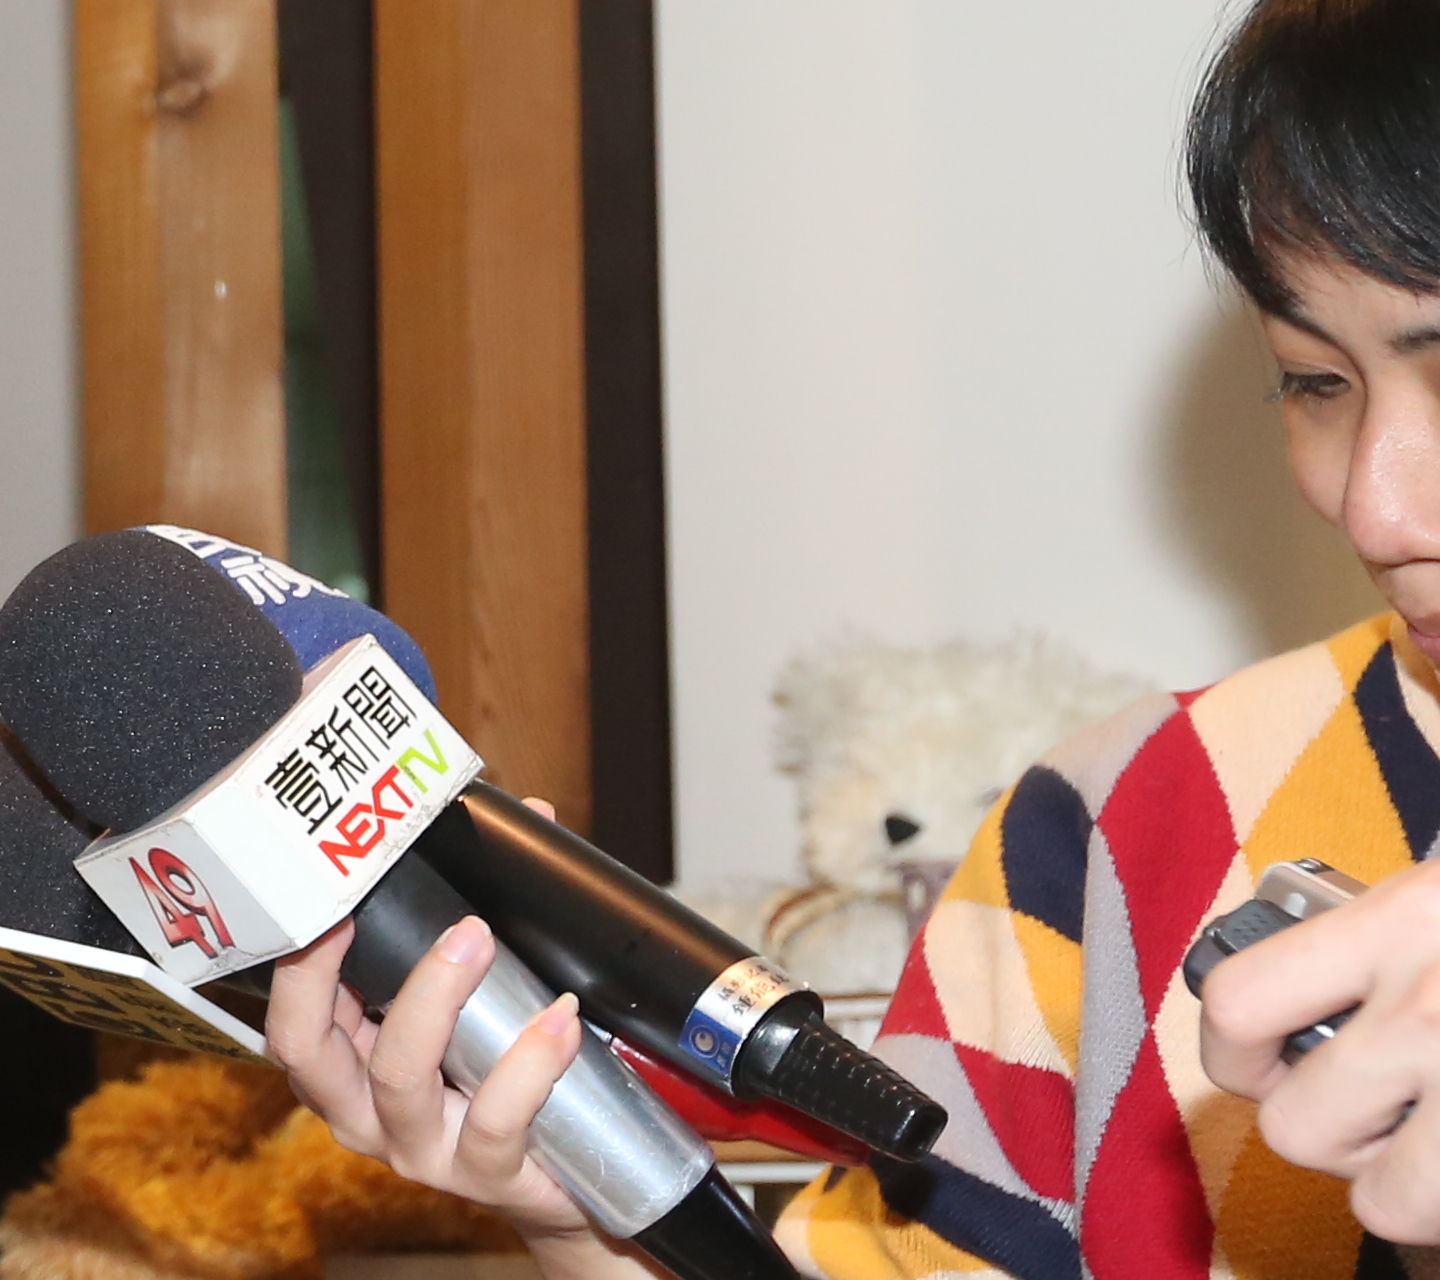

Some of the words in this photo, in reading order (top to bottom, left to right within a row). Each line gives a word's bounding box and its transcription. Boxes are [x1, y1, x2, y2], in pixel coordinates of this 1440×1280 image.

[264, 665, 419, 835] 壹新聞
[128, 847, 237, 960] 49
